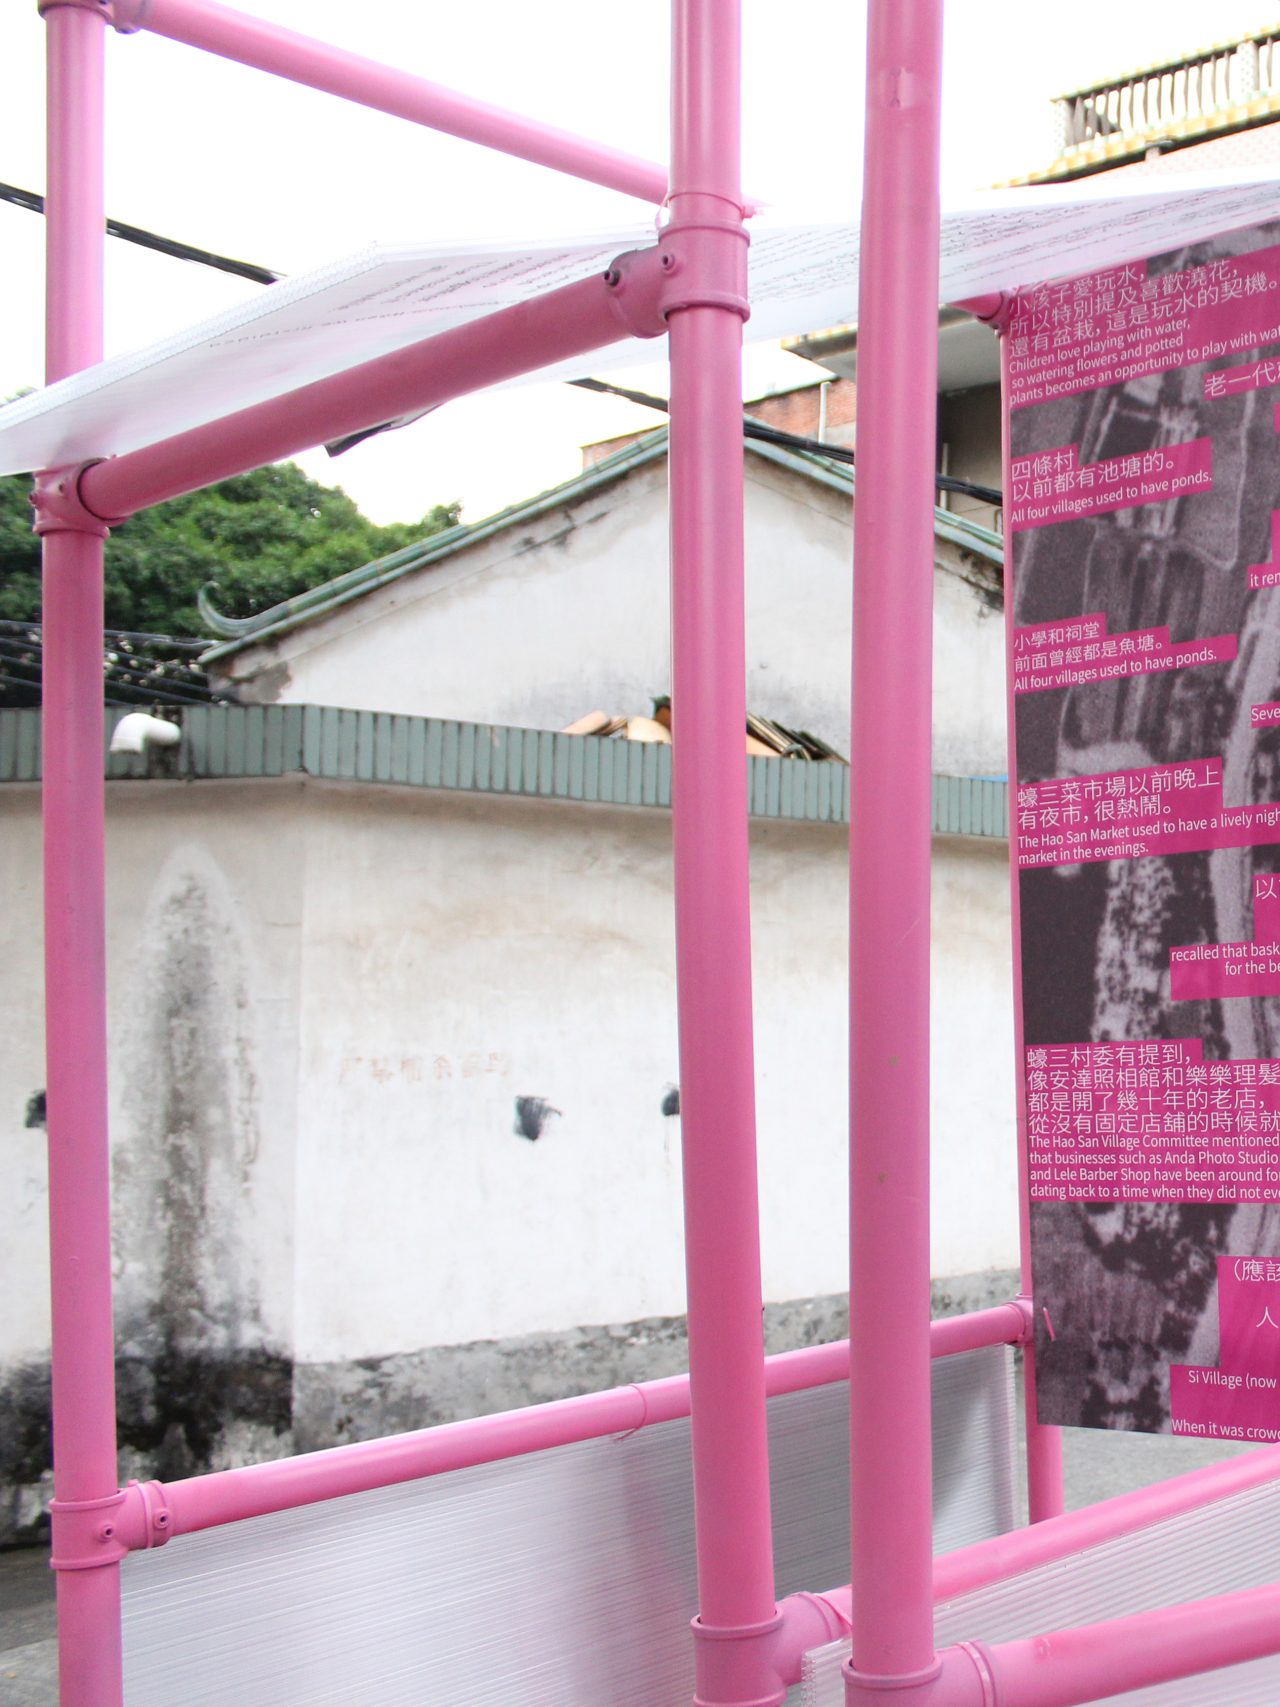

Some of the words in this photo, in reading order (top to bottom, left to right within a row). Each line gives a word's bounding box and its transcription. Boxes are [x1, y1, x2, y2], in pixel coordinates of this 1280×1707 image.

[1008, 353, 1054, 372] Children
[1057, 347, 1080, 361] love
[1082, 335, 1124, 357] playing
[1126, 325, 1152, 342] with
[1154, 319, 1190, 335] water,
[1011, 377, 1024, 388] so
[1026, 363, 1074, 383] watering
[1076, 353, 1117, 371] flowers
[1120, 343, 1142, 360] and
[1145, 333, 1183, 356] potted
[1012, 449, 1074, 482] 四條村
[1013, 451, 1174, 502] 以前都有池塘的。
[1010, 508, 1024, 522] All
[1027, 506, 1049, 519] four
[1051, 497, 1093, 514] villages
[1095, 487, 1123, 504] used
[1126, 487, 1138, 498] to
[1140, 481, 1168, 495] have
[1171, 471, 1215, 492] ponds.
[1250, 574, 1258, 587] it
[1014, 621, 1100, 651] 小學和祠堂
[1014, 634, 1162, 673] 前面曾經都是魚塘。
[1018, 765, 1220, 810] 蠔三菜市場以前晚上
[1018, 849, 1057, 864] market
[1060, 847, 1070, 860] in
[1072, 845, 1091, 859] the
[1093, 841, 1148, 857] evenings.
[1224, 962, 1242, 975] for
[1244, 961, 1265, 974] the
[1027, 1043, 1191, 1069] 蠔三村委有提到，
[1028, 1087, 1265, 1113] 都是開了幾十年的老店，
[1028, 1135, 1049, 1148] The
[1052, 1135, 1075, 1148] Hao
[1077, 1134, 1098, 1147] San
[1101, 1134, 1139, 1150] Village
[1142, 1134, 1208, 1147] Committee
[1212, 1133, 1279, 1147] mentioned
[1030, 1167, 1051, 1180] and
[1054, 1167, 1077, 1181] Lele
[1079, 1168, 1118, 1181] Barber
[1120, 1168, 1150, 1184] Shop
[1153, 1168, 1182, 1181] have
[1185, 1168, 1214, 1181] been
[1218, 1168, 1262, 1181] around
[1171, 1418, 1205, 1433] When
[1208, 1420, 1216, 1433] it
[1219, 1425, 1244, 1435] was
